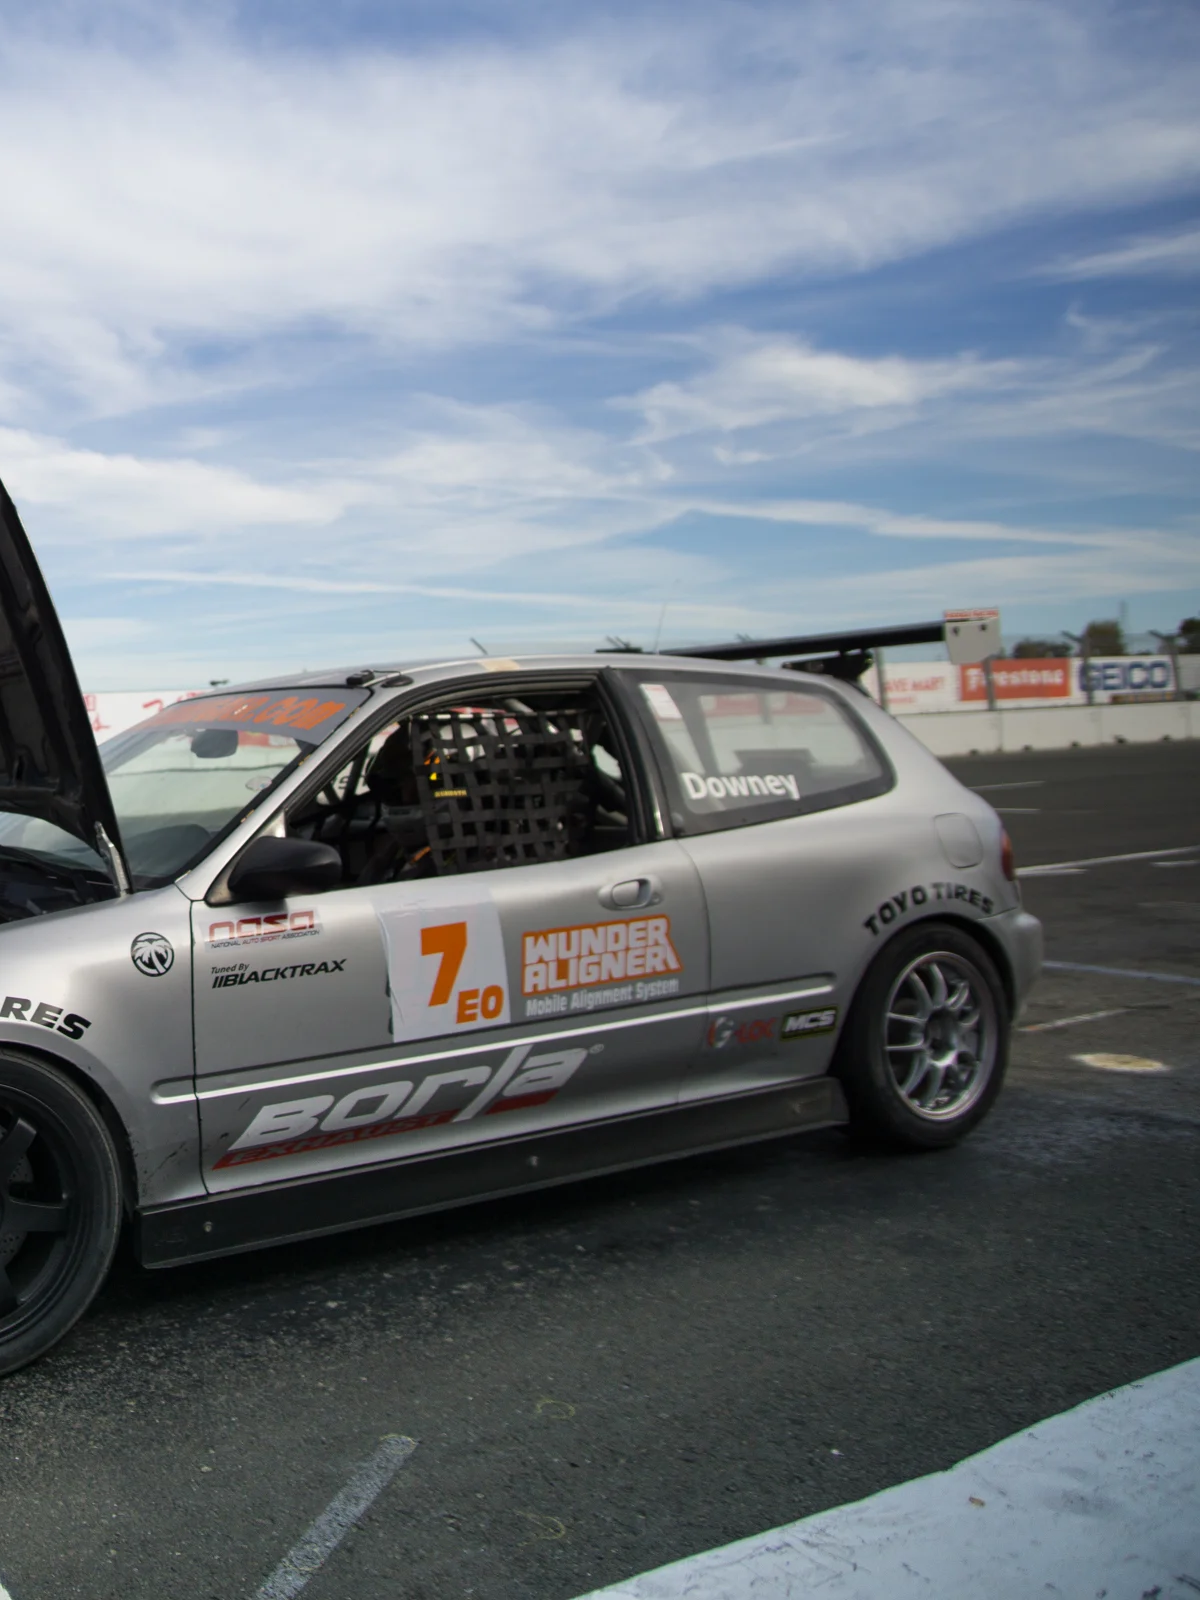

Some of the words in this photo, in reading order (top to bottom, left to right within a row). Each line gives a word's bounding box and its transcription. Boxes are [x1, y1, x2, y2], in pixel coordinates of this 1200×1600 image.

[965, 668, 1064, 691] Frestone
[681, 772, 800, 800] Downey
[863, 885, 928, 936] TOYO
[931, 882, 995, 915] TIRES
[523, 916, 676, 966] WUNDER
[211, 964, 236, 975] Tuned
[238, 962, 250, 972] By
[420, 921, 468, 1007] 7
[523, 944, 682, 993] ALIGNER
[526, 993, 567, 1017] Mobile
[570, 984, 634, 1011] Alignment
[635, 978, 679, 1000] System
[785, 1010, 836, 1032] MCS
[230, 1112, 446, 1164] EXHAUST
